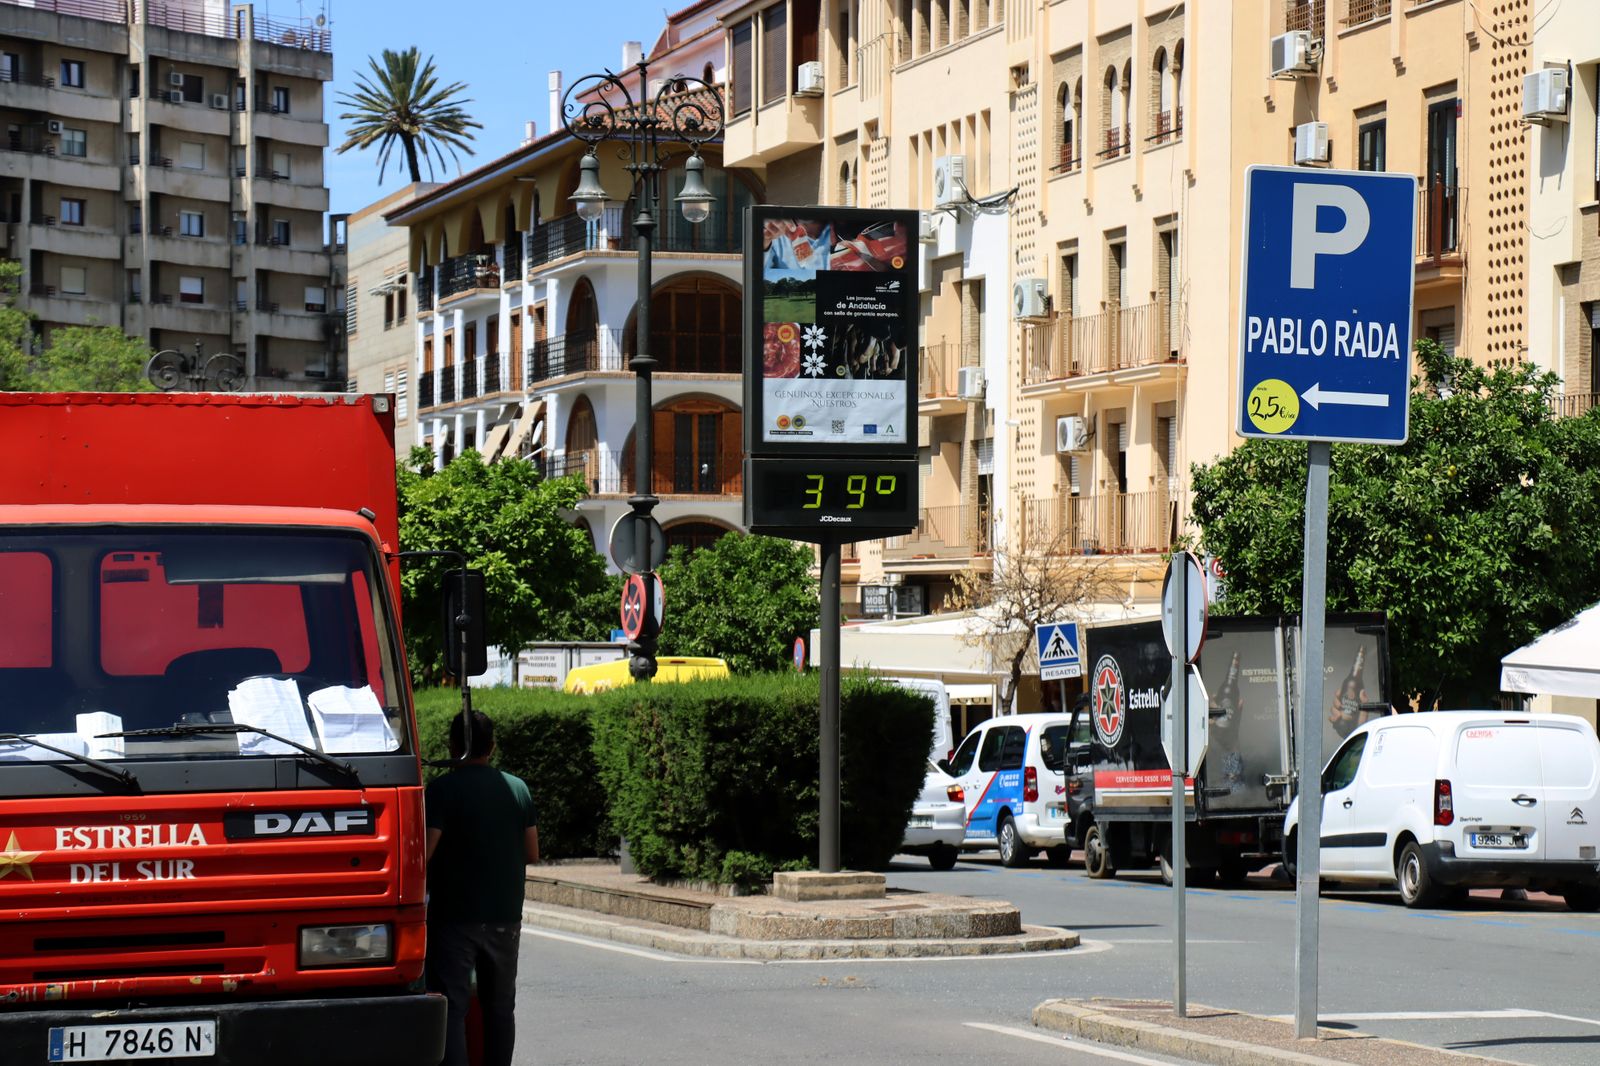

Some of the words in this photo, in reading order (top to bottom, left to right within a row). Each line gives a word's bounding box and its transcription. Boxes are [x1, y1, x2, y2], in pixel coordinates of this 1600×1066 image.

[1290, 182, 1370, 290] P
[836, 301, 847, 309] de
[848, 301, 887, 310] Andalucía
[1247, 316, 1328, 357] PABLO
[1334, 320, 1400, 360] RADA
[811, 399, 857, 409] NUESTROS
[819, 515, 852, 523] JCDecaux
[1045, 668, 1077, 678] RESALTO
[1129, 688, 1160, 710] Estrella
[1115, 775, 1144, 784] CERVECEROS
[1144, 775, 1159, 783] DESDE
[254, 810, 369, 835] DAF
[54, 823, 209, 851] ESTRELLA
[1477, 834, 1502, 846] 9296
[69, 862, 130, 884] DEL
[136, 859, 198, 881] SUR
[69, 1031, 86, 1058] H
[105, 1027, 174, 1057] 7846
[185, 1026, 202, 1052] N
